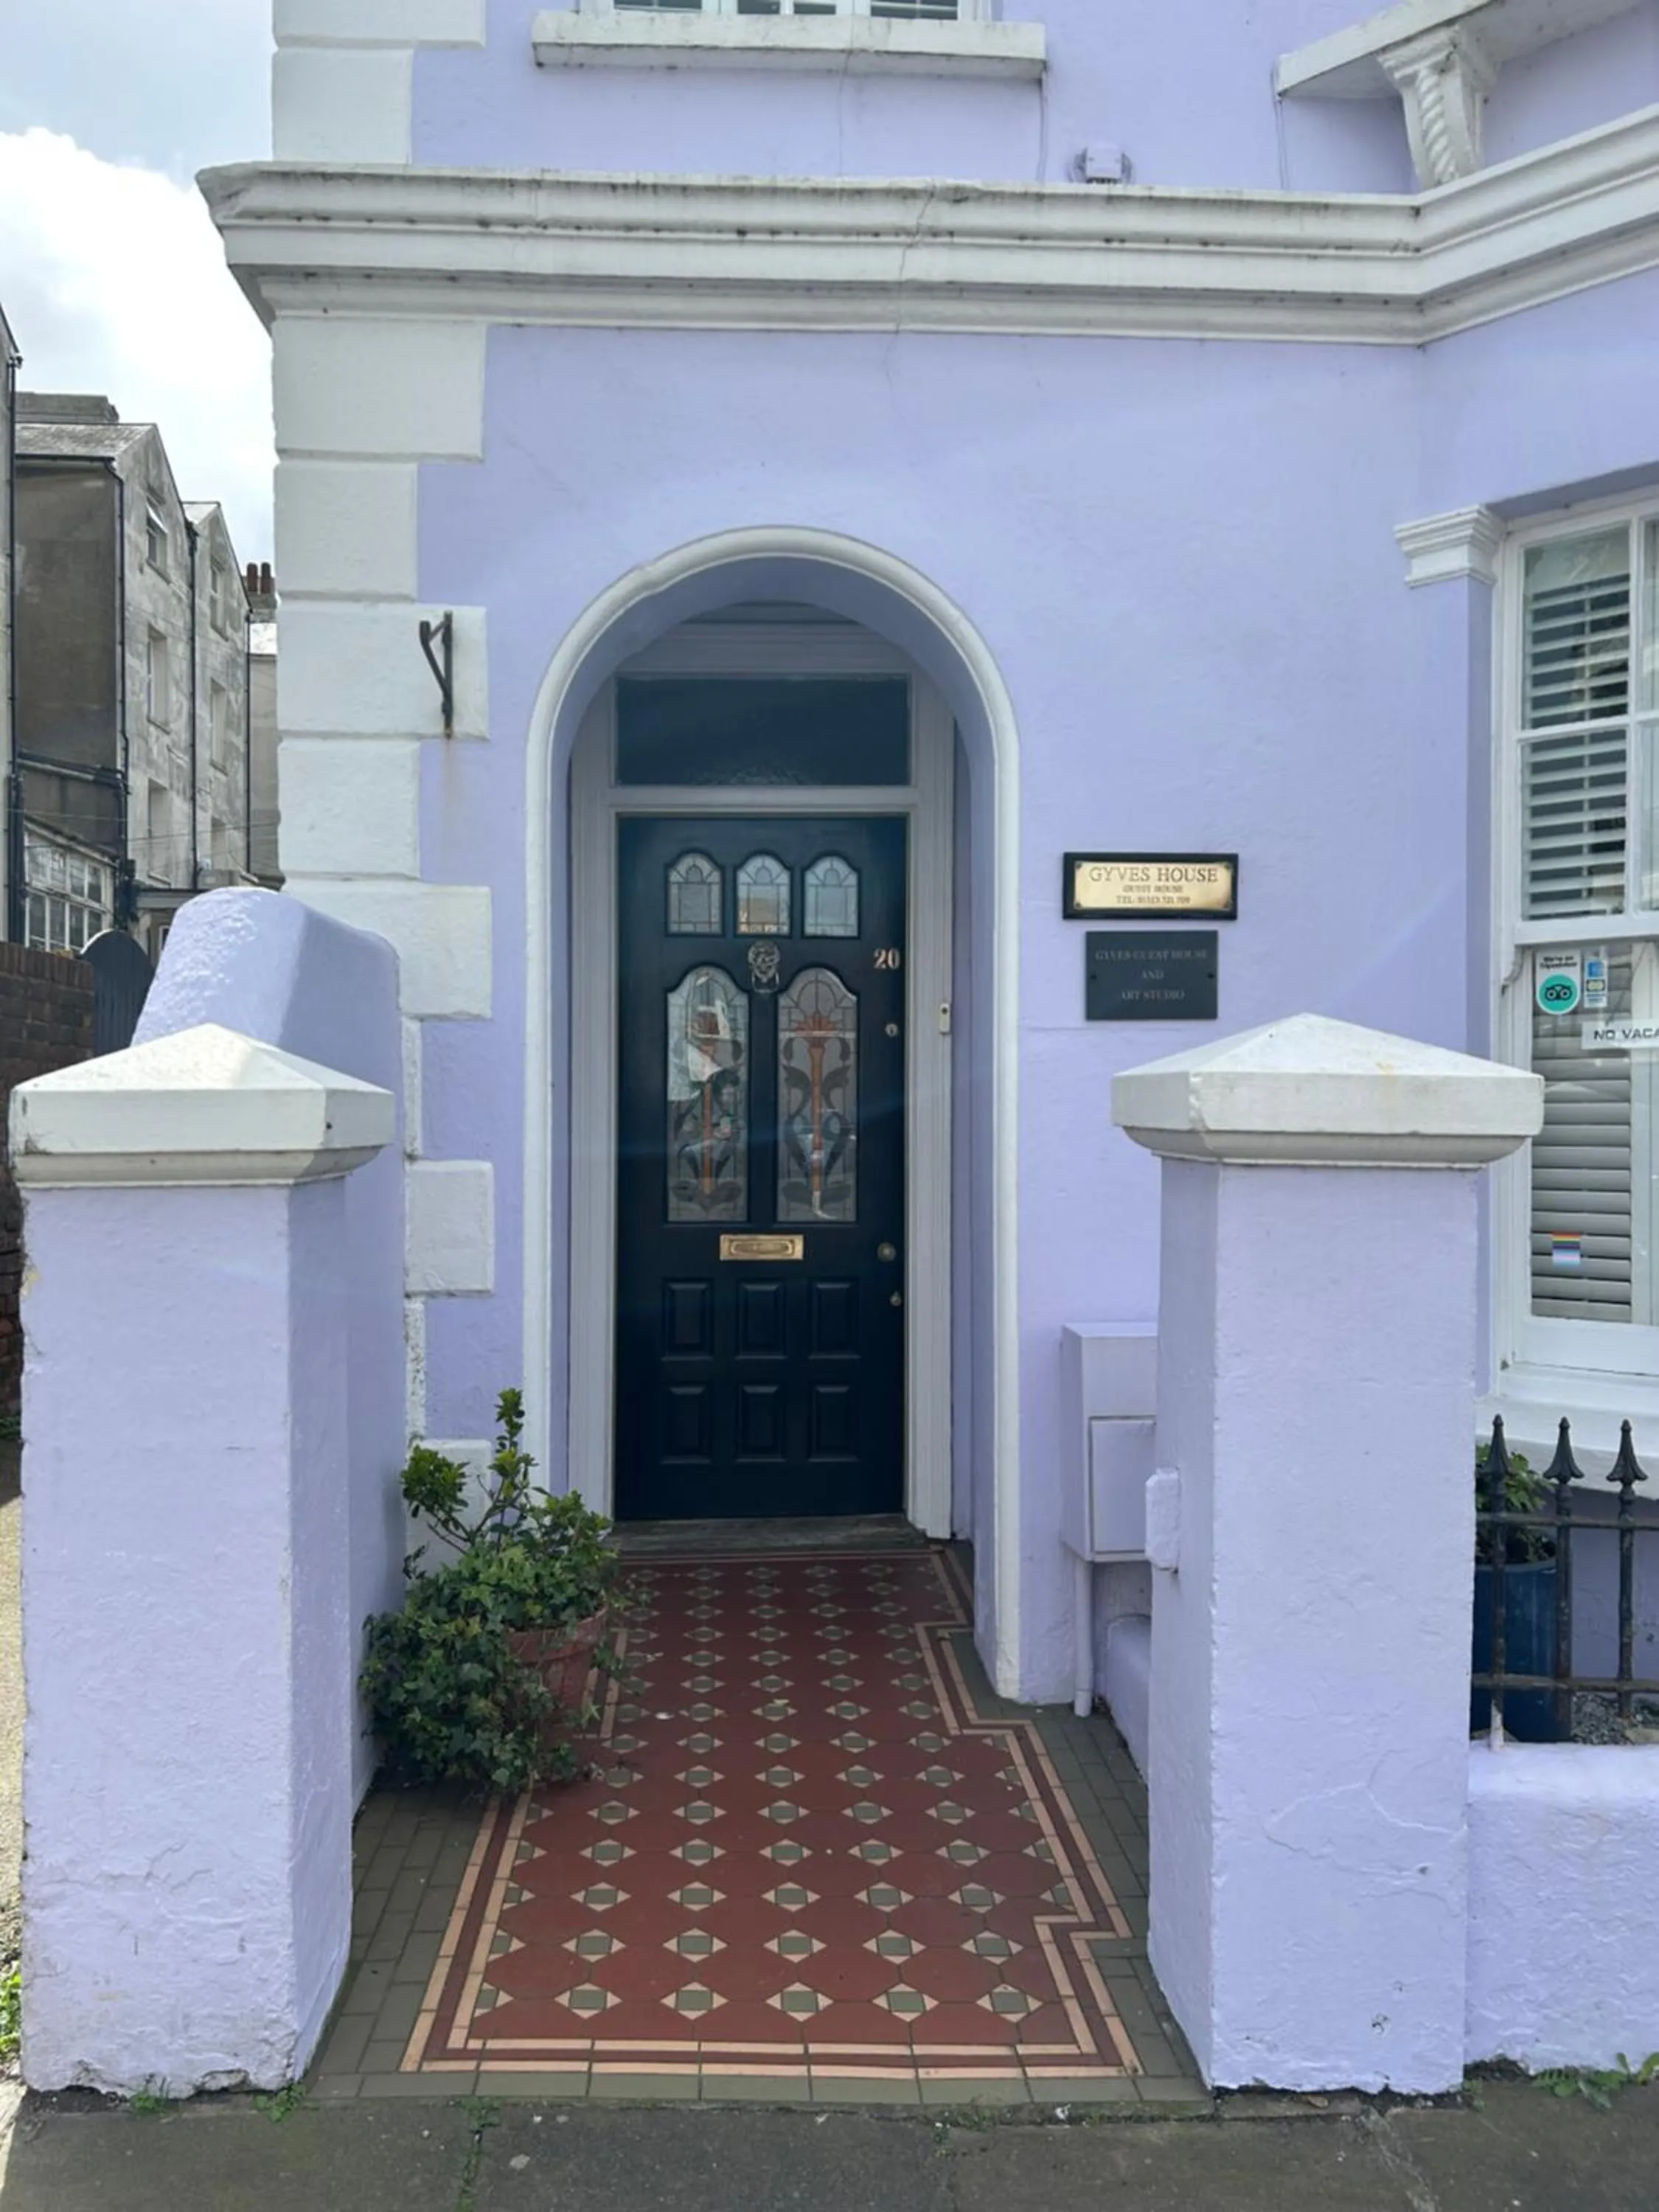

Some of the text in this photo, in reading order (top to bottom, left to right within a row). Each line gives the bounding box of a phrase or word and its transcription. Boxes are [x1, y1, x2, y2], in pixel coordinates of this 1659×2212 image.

[1088, 866, 1219, 883] GYVES HOUSE
[874, 949, 900, 970] 20
[1142, 969, 1165, 980] AND
[1593, 1029, 1615, 1040] NO
